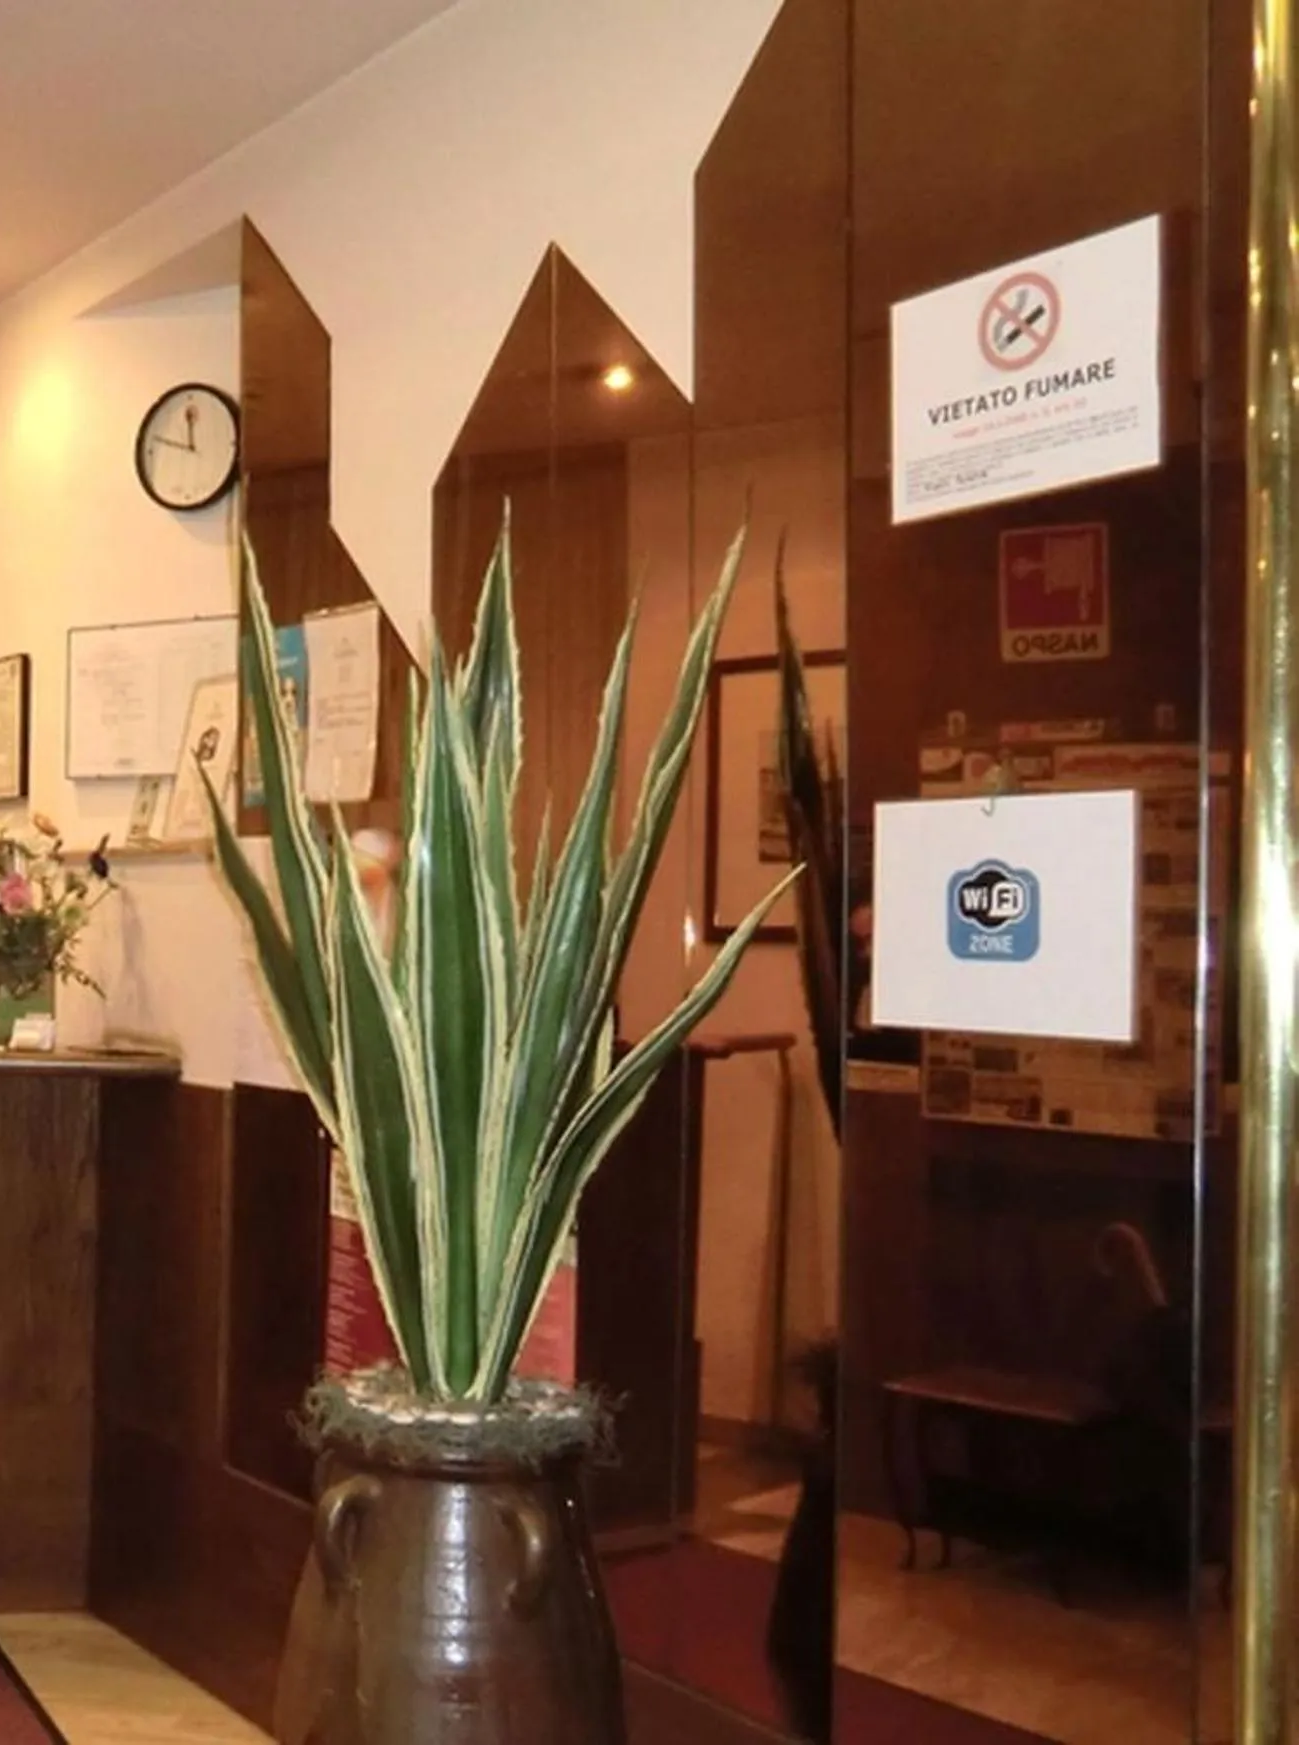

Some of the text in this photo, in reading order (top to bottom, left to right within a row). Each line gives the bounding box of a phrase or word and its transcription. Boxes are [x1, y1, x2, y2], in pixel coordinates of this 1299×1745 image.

[927, 386, 1018, 426] VIETATO
[1023, 357, 1117, 402] FUMARE
[968, 934, 1014, 954] ZONE
